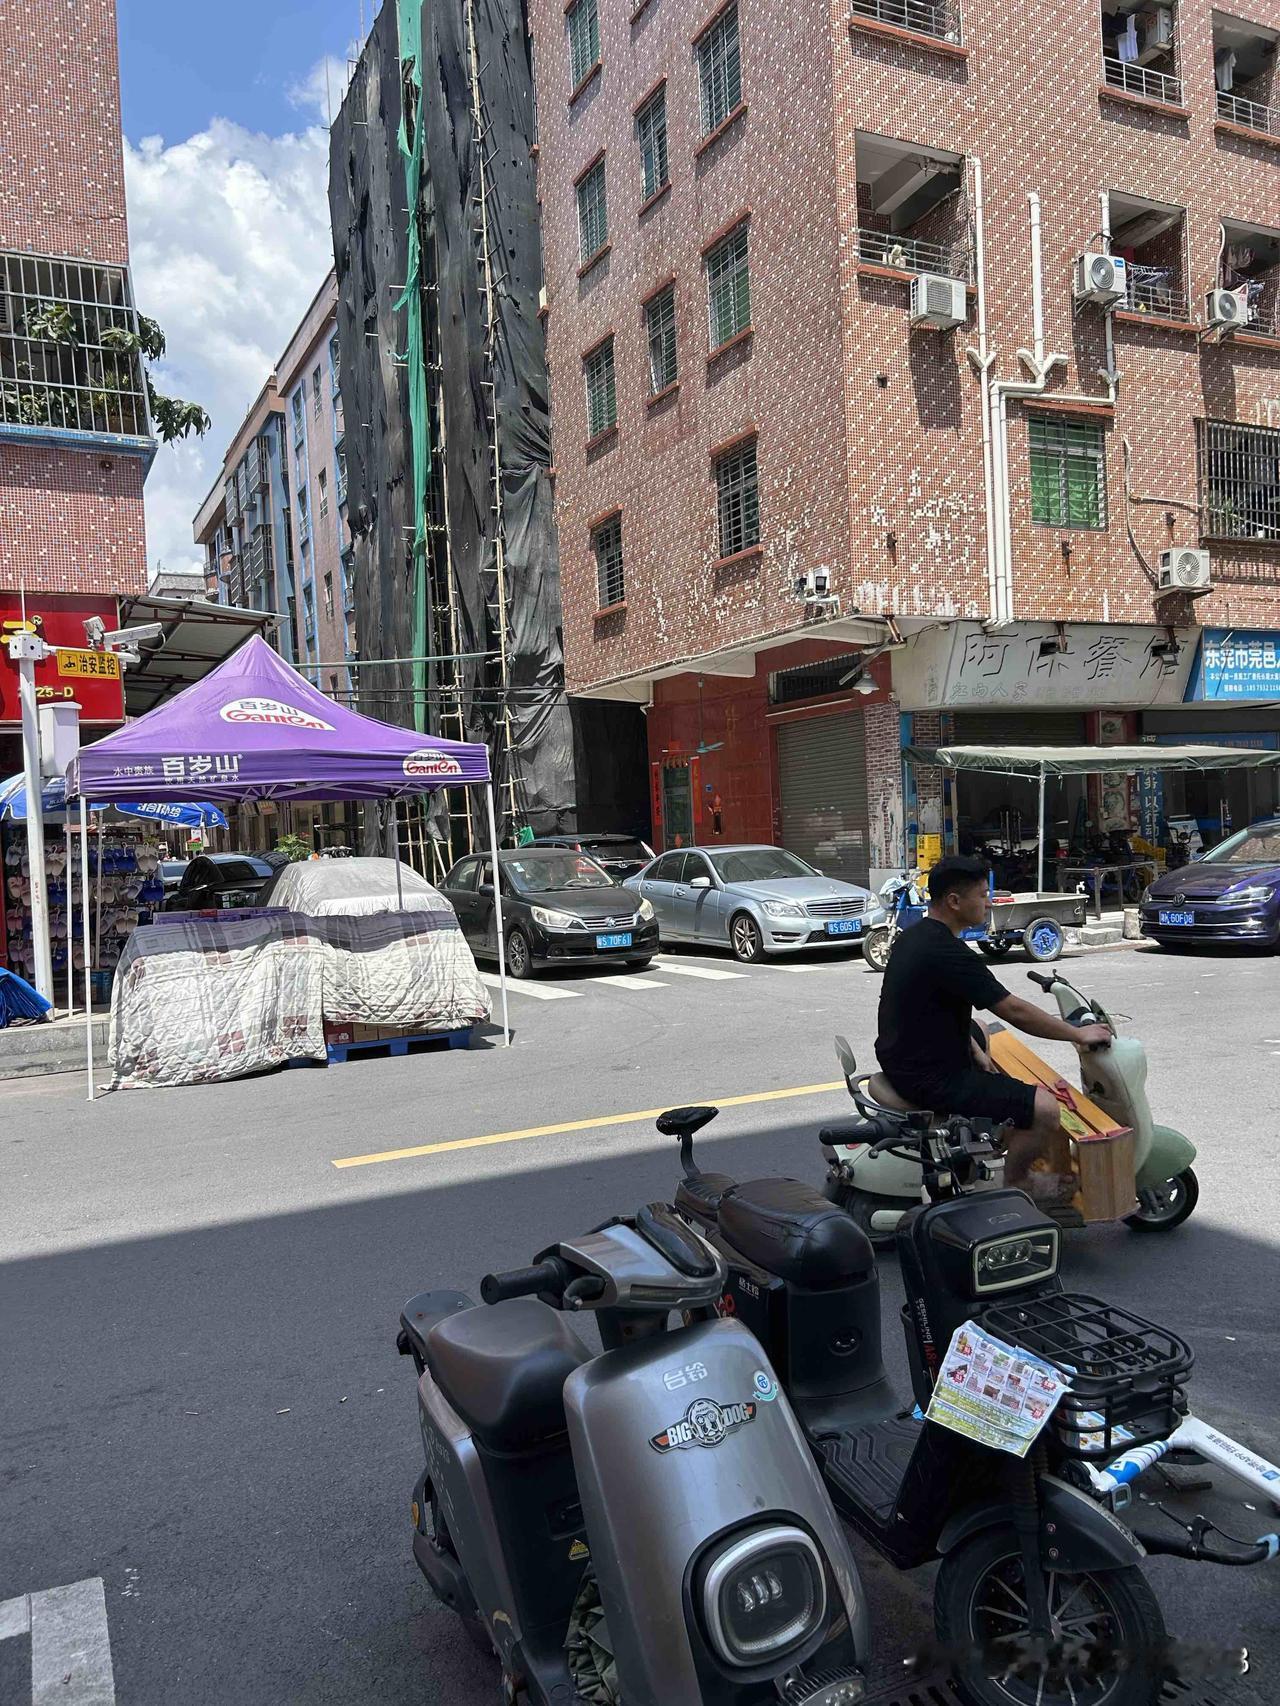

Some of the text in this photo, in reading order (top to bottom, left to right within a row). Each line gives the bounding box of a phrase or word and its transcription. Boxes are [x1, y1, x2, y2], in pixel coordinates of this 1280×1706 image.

[79, 655, 116, 675] 治安监控
[1205, 641, 1280, 668] 东莞市莞邑
[239, 701, 298, 717] 百岁山
[161, 754, 239, 777] 百岁山
[663, 1362, 708, 1391] 台铃
[666, 1403, 750, 1447] BIG DOG
